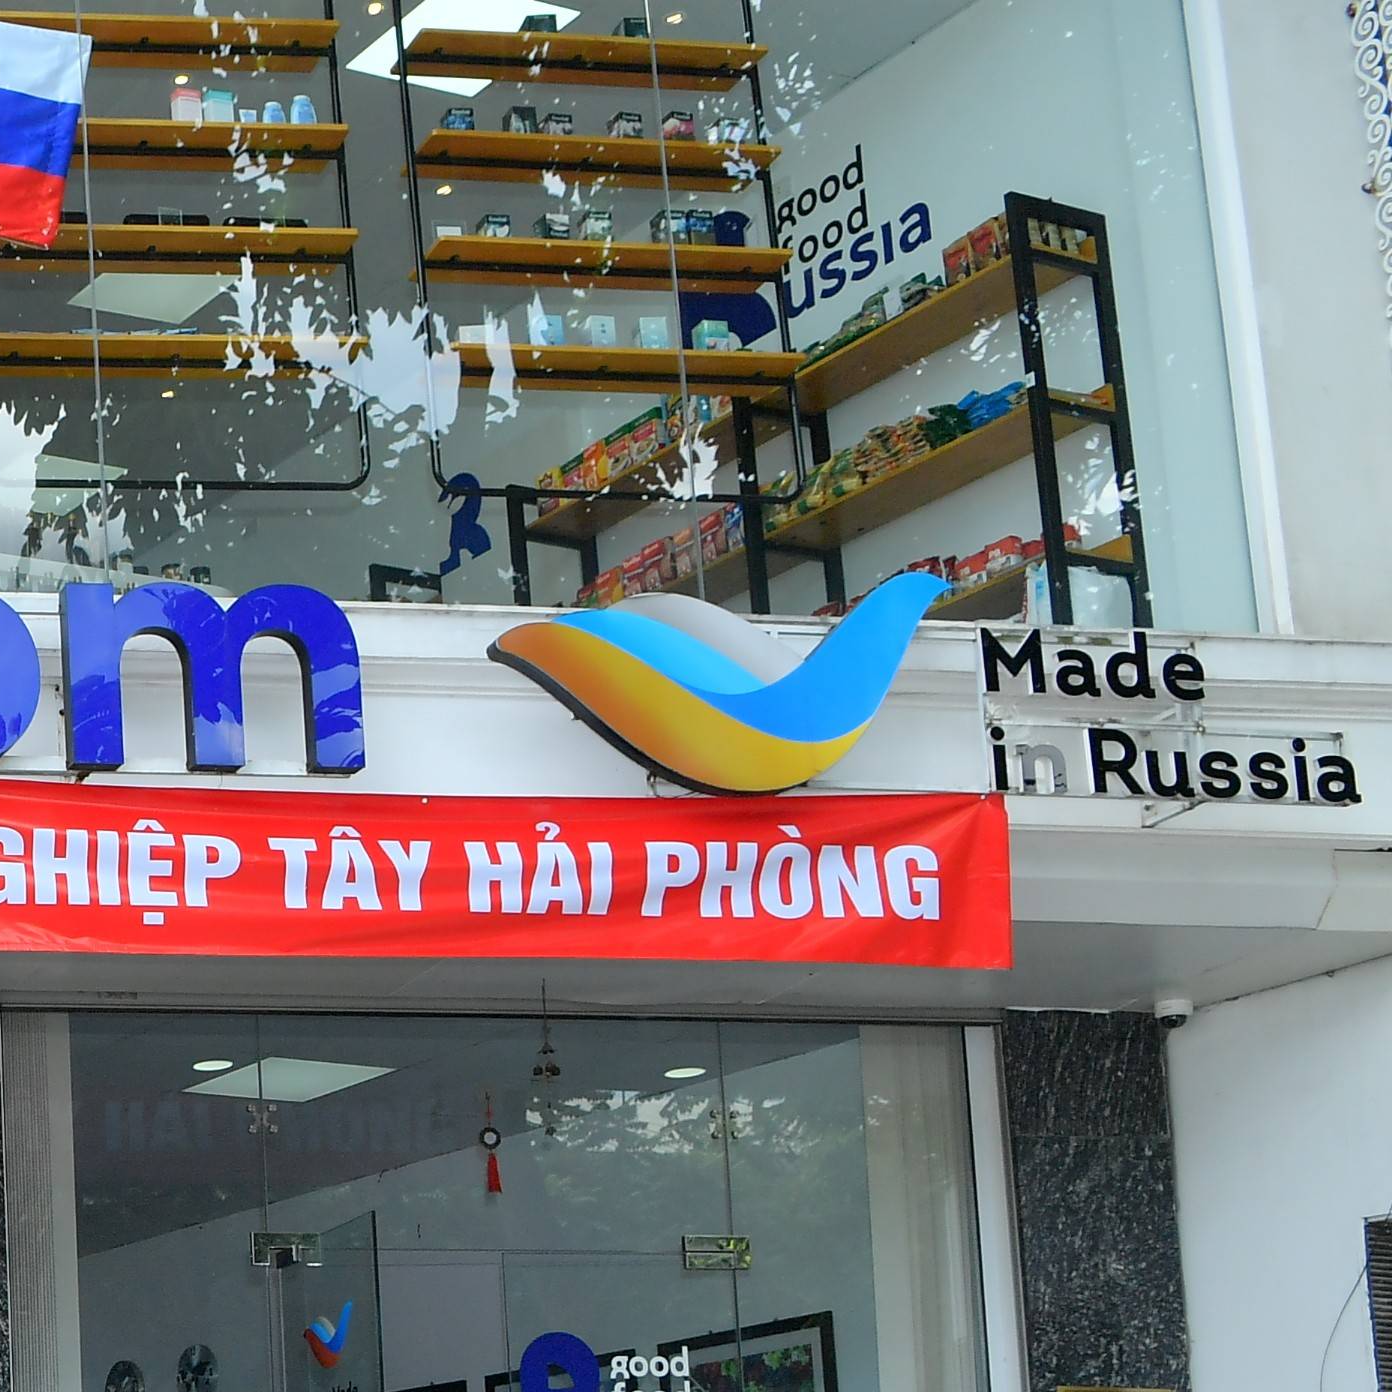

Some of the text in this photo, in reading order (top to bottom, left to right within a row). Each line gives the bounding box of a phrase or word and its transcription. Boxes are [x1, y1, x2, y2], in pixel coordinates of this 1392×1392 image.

[980, 628, 1206, 700] Made
[991, 726, 1363, 804] in Russia
[267, 826, 433, 911] TÂY
[463, 820, 614, 916] HẢI
[641, 825, 941, 921] PHÒNG
[610, 1346, 690, 1380] good
